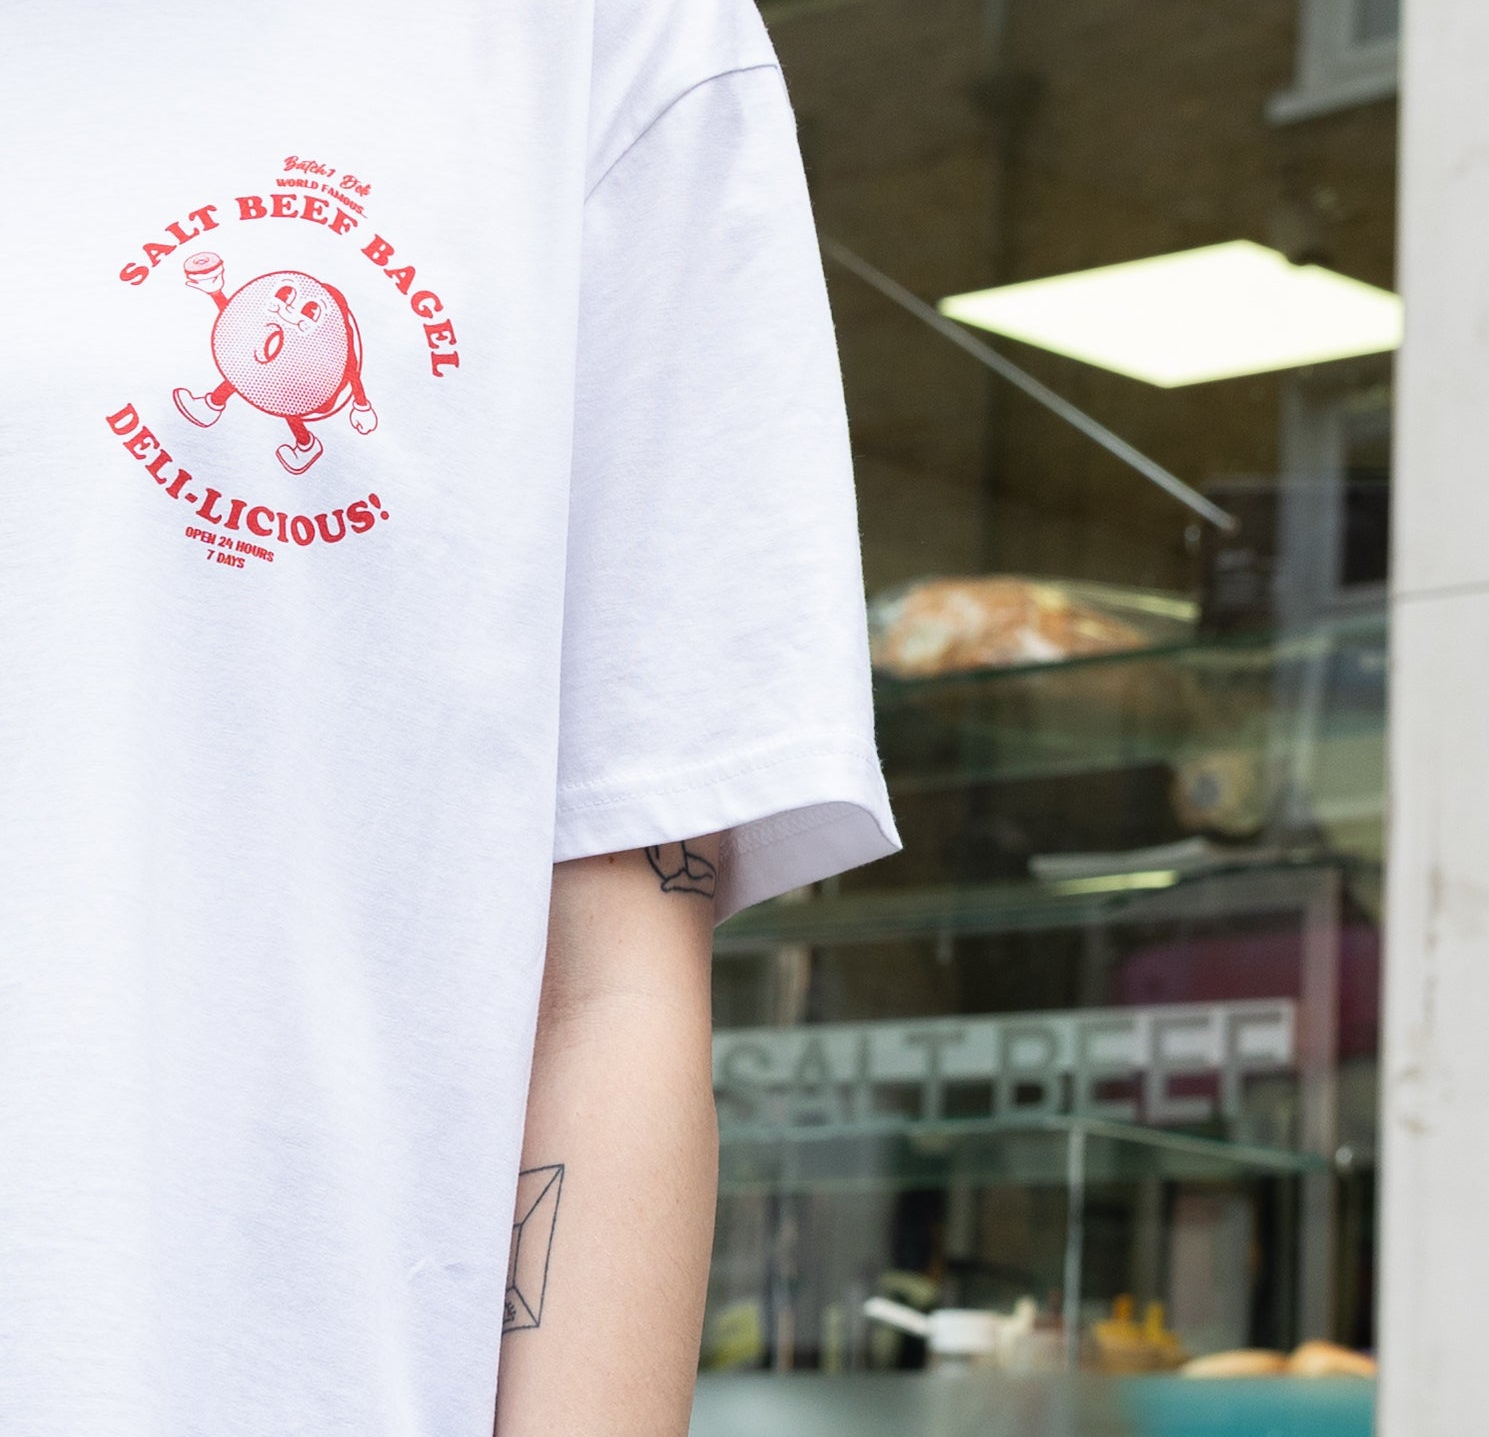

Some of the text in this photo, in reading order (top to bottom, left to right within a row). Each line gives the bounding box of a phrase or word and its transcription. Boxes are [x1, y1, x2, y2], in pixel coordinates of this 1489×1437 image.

[276, 178, 319, 190] WORLD
[119, 193, 461, 379] SALT BEEF BAGEL
[105, 402, 390, 548] DELI-LICIOUS!
[185, 526, 275, 563] OPEN 24 HOURS
[206, 548, 246, 569] 7 DAYS
